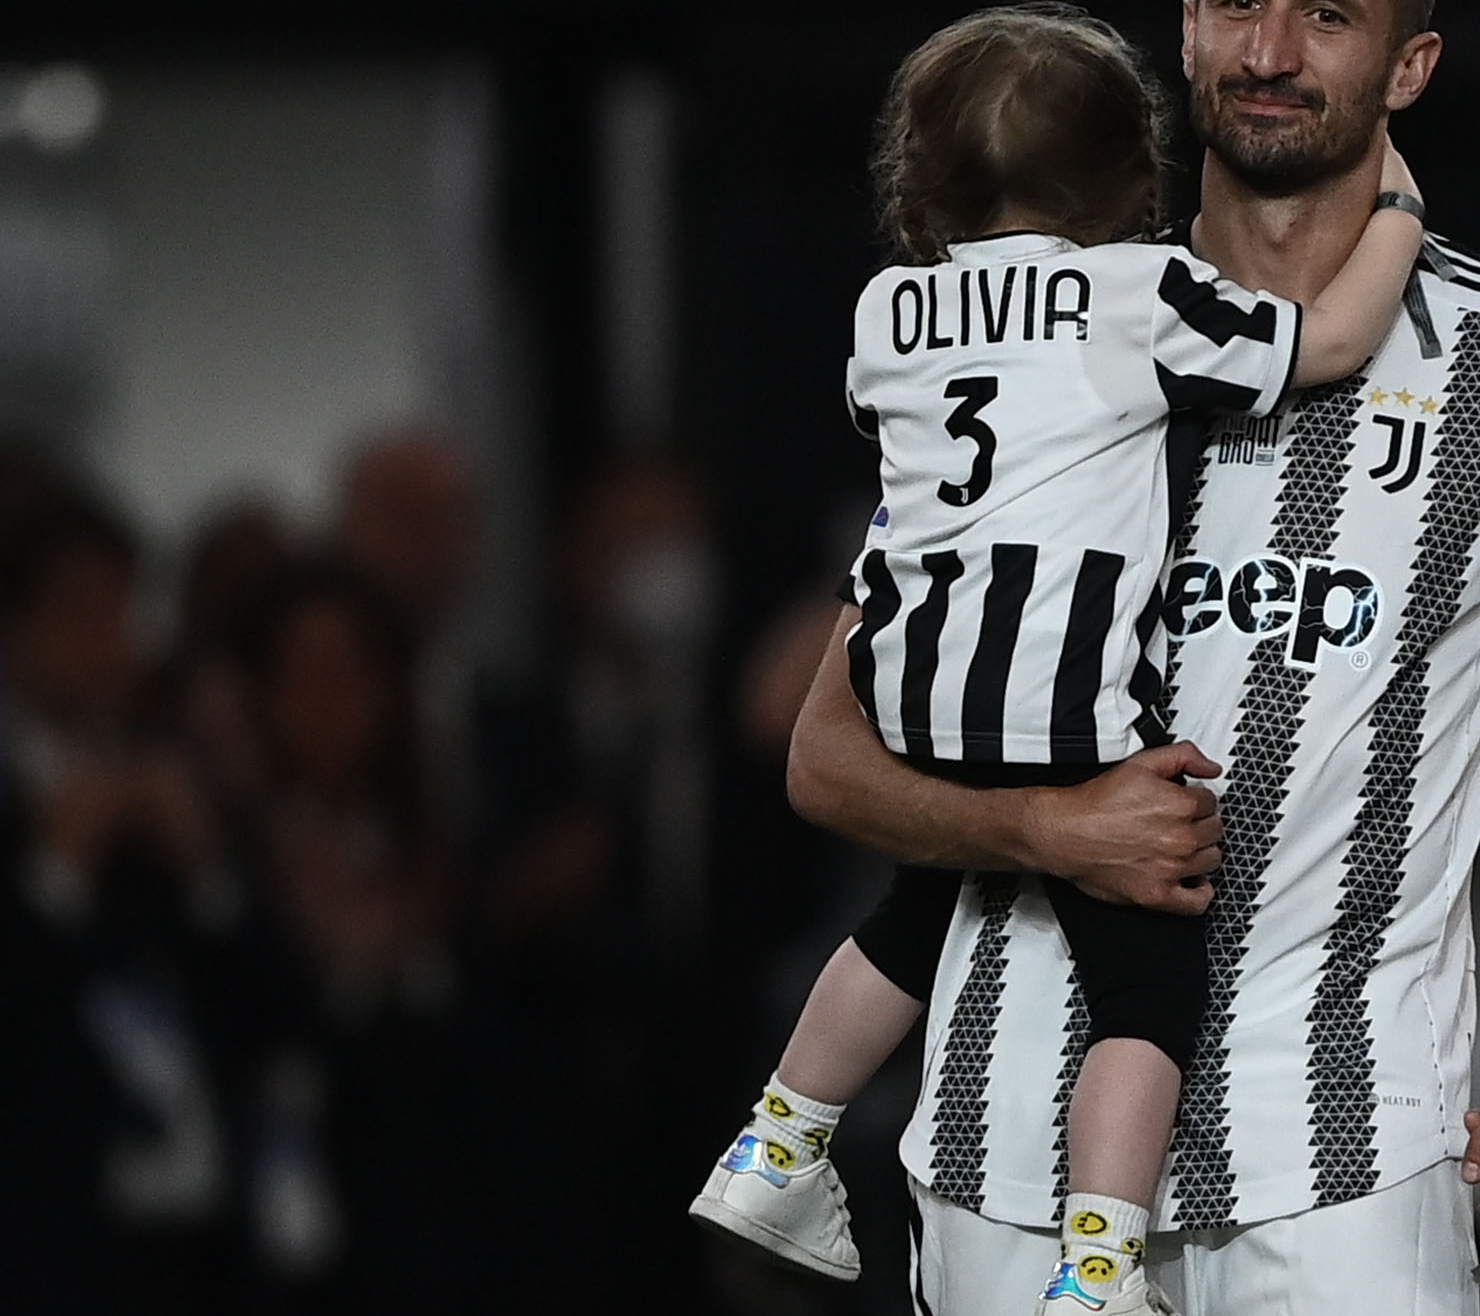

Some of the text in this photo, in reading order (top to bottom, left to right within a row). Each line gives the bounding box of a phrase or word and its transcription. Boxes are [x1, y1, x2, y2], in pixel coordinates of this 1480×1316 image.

[892, 266, 1090, 354] OLIVIA
[938, 377, 997, 506] 3
[1161, 558, 1380, 664] eep
